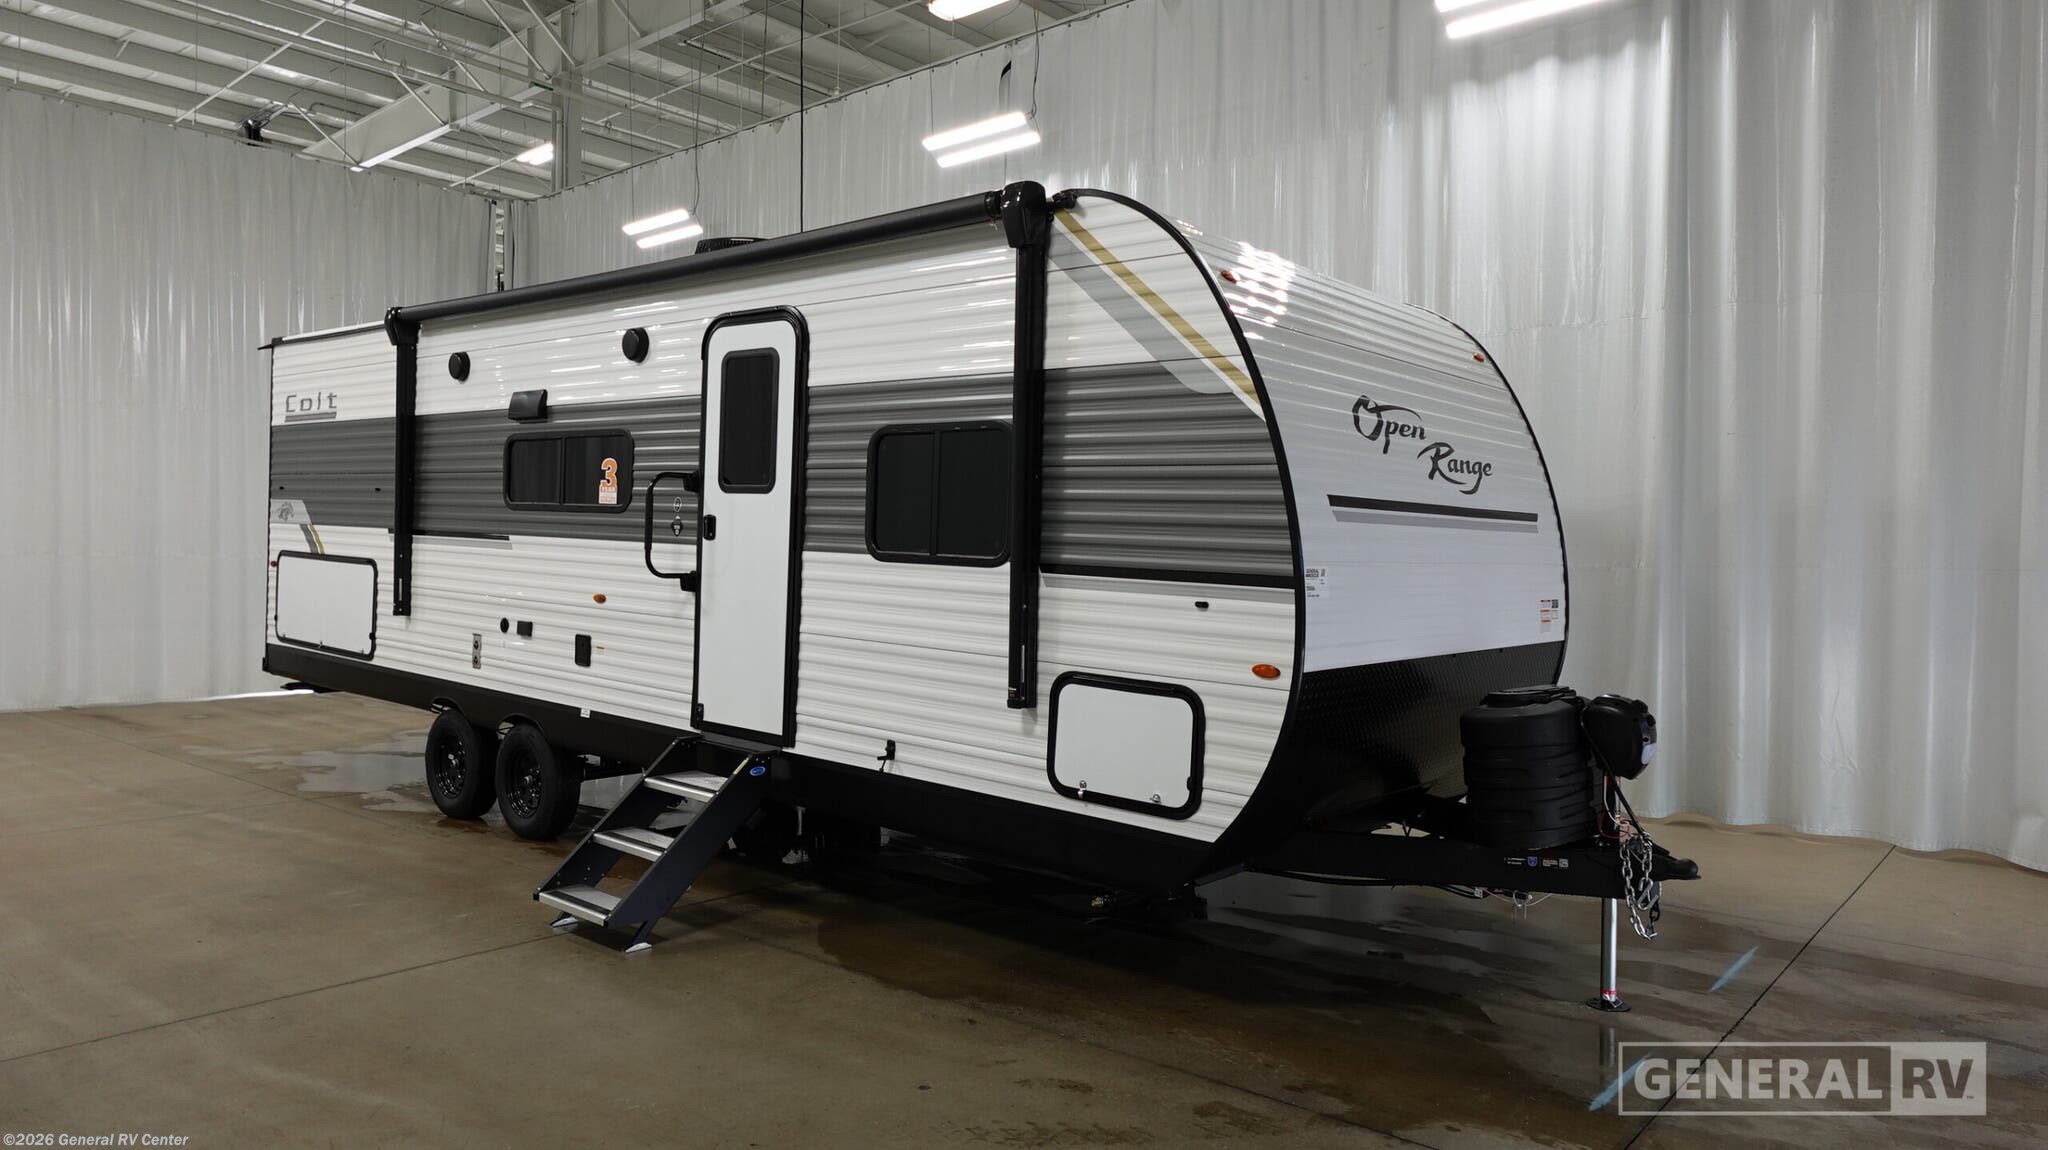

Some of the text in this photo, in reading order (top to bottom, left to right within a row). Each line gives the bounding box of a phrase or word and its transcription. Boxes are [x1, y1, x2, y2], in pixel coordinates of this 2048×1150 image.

[286, 392, 337, 412] Colt
[1352, 395, 1426, 454] Open
[600, 458, 617, 487] 3
[1417, 442, 1493, 494] Range
